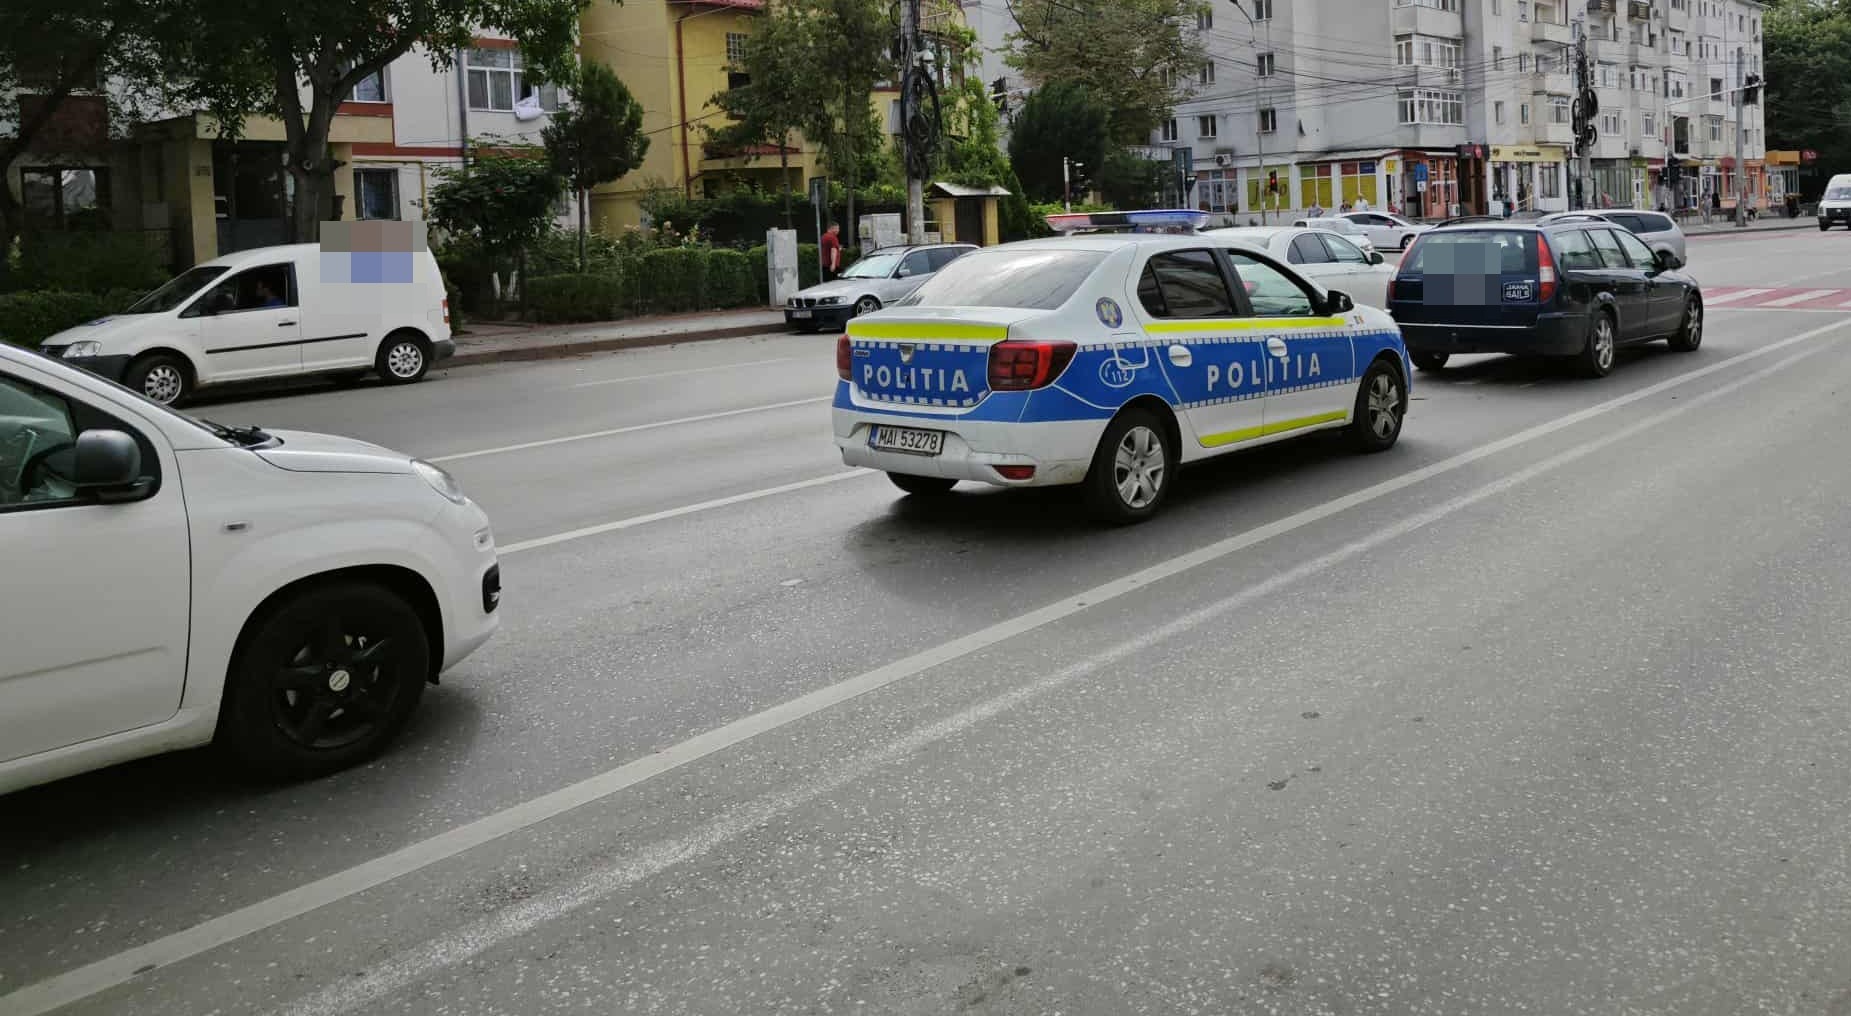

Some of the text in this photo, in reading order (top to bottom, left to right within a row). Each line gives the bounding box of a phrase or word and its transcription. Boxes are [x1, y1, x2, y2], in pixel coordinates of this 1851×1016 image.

[863, 364, 969, 392] POLITIA
[1112, 369, 1129, 383] 112
[1207, 352, 1321, 392] POLITIA
[878, 429, 938, 450] MAI 53278
